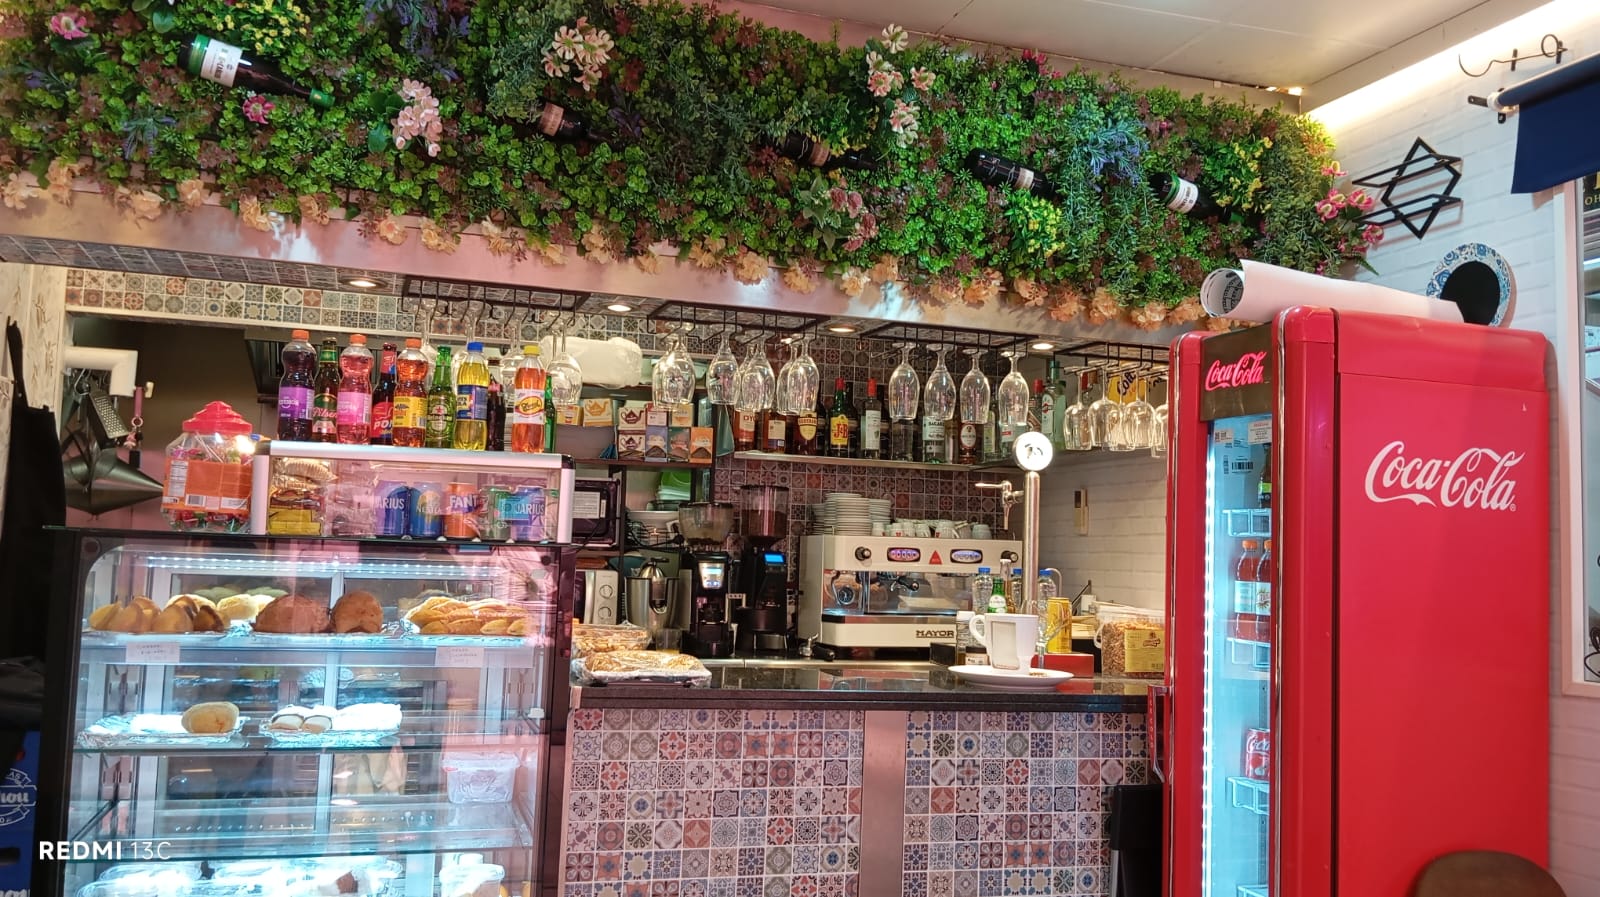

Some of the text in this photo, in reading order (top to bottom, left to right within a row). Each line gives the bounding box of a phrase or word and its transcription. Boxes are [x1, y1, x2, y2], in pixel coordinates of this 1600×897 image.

[1205, 351, 1267, 391] Coca-Cola
[373, 420, 392, 430] PO
[1365, 440, 1526, 511] Coca-Cola
[916, 630, 955, 638] MAYOR
